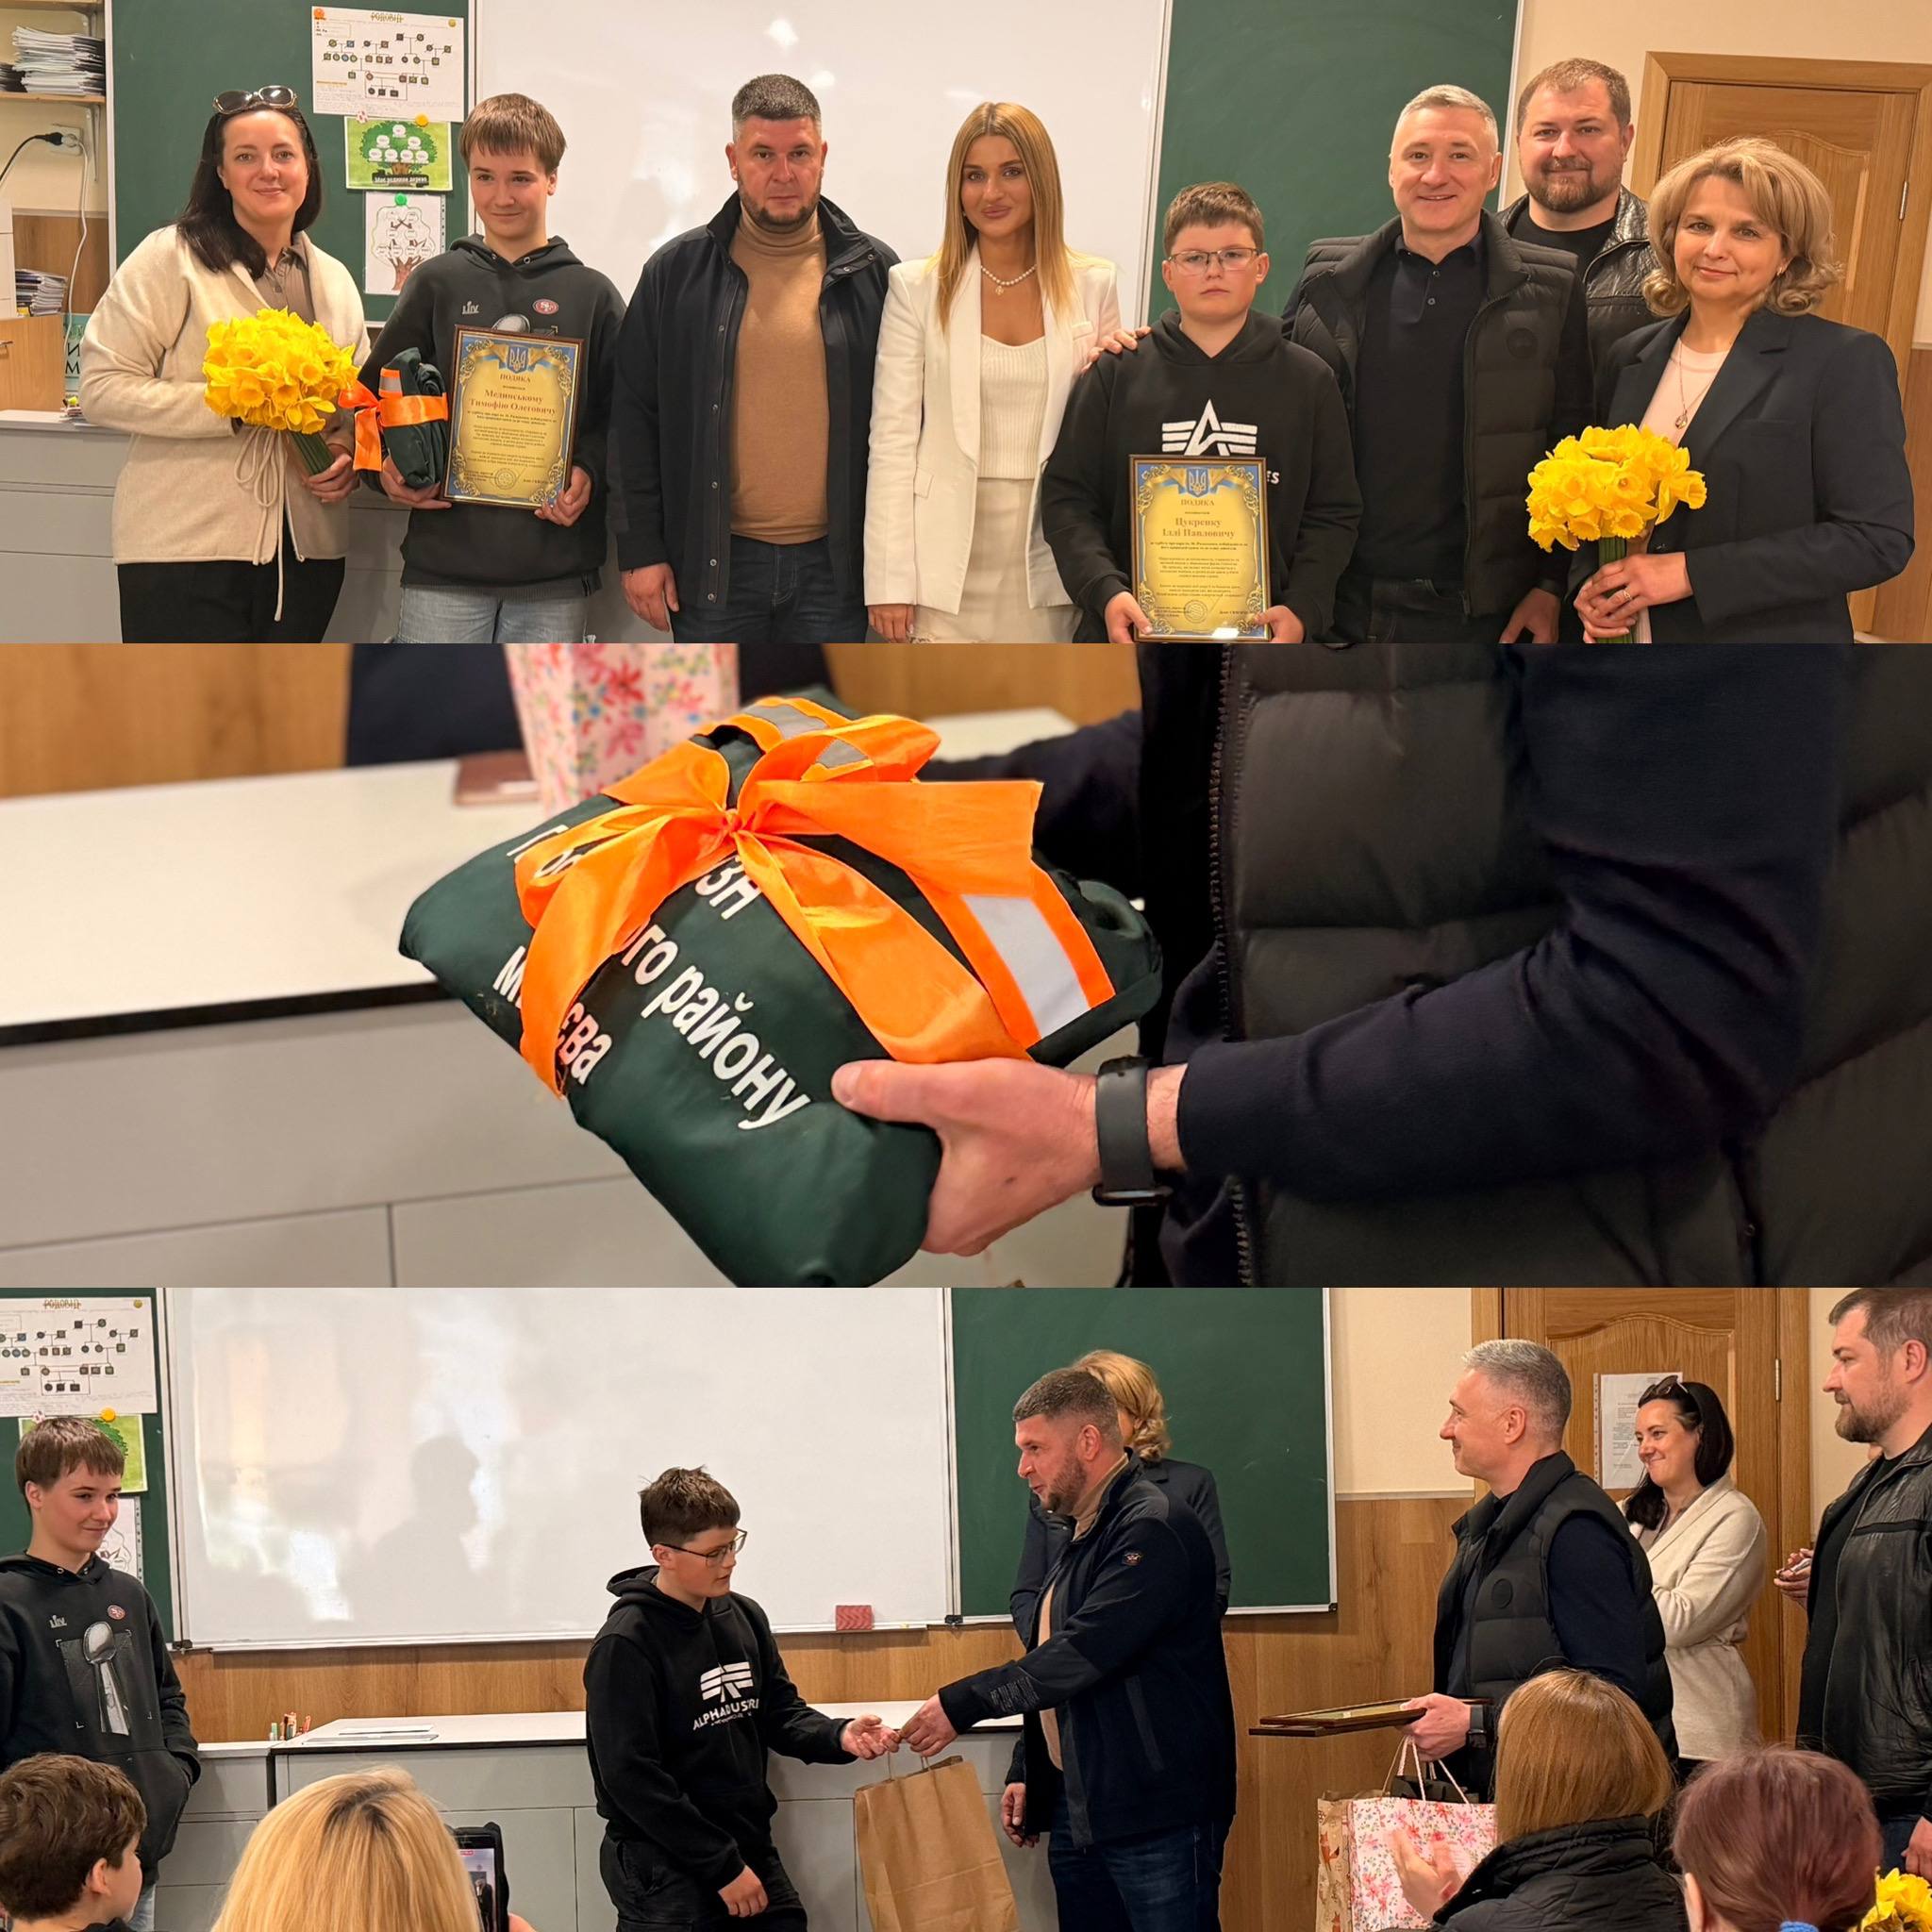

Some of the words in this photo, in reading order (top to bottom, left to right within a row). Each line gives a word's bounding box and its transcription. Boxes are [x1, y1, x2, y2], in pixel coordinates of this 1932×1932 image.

[500, 373, 531, 383] ПОДЯКА
[1180, 498, 1215, 507] ПОДЯКА
[641, 965, 811, 1130] району
